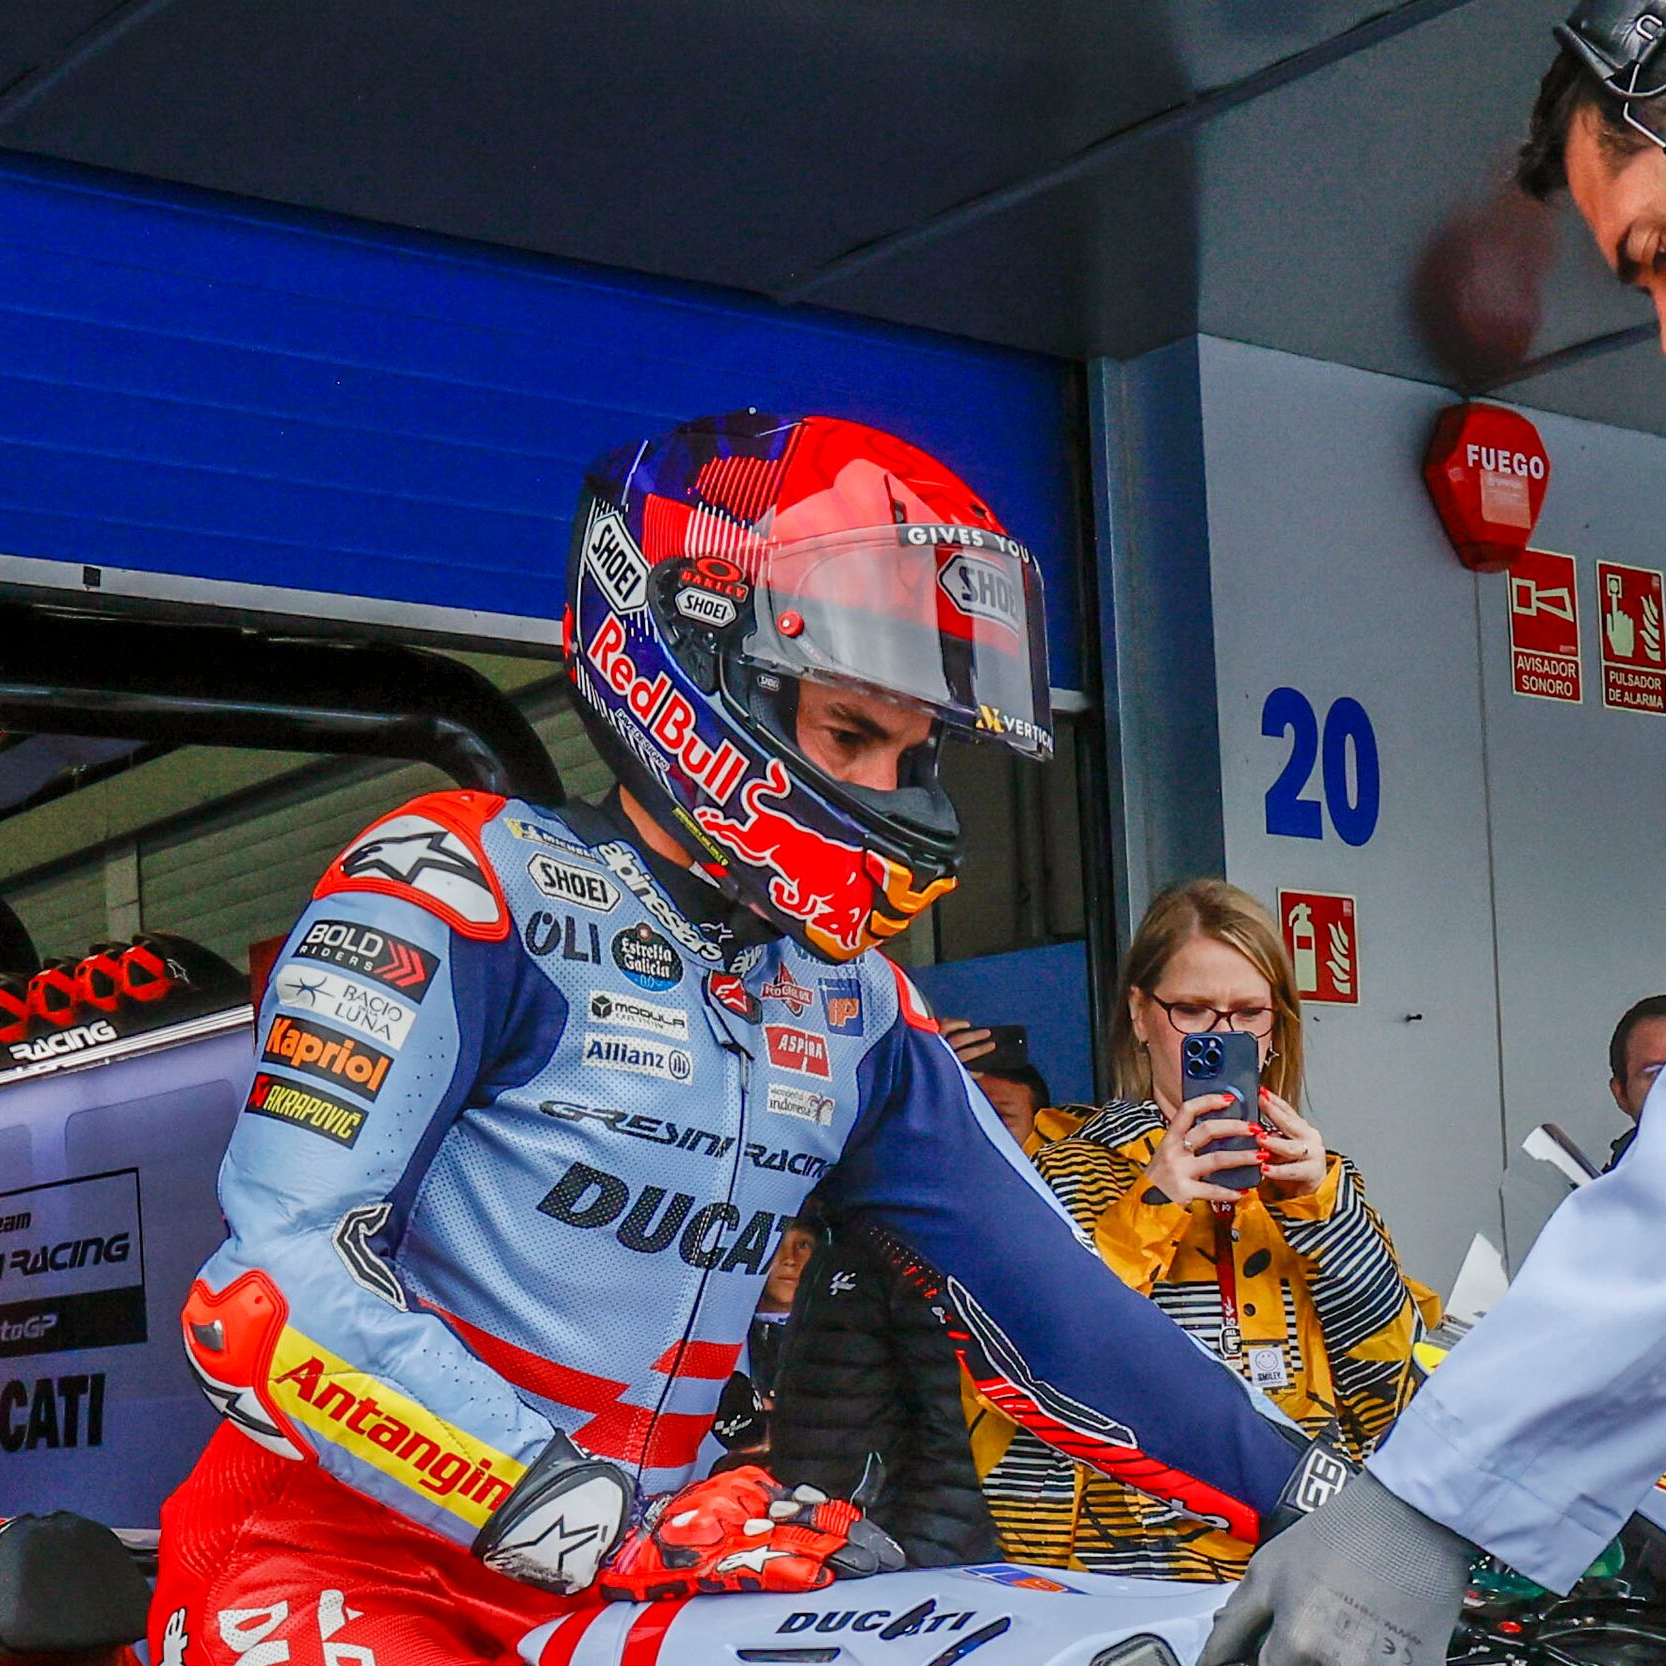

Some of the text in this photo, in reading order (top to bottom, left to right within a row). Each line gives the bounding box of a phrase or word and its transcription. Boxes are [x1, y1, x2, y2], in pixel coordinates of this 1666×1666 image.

[1466, 443, 1545, 480] FUEGO
[590, 523, 643, 602] SHOEI
[908, 526, 1030, 564] GIVES YOU
[680, 568, 748, 600] OAKLEY
[685, 593, 729, 620] SHOEI
[1516, 655, 1577, 680] AVISADOR
[1608, 670, 1663, 691] PULSADOR
[1521, 674, 1574, 698] SONORO
[1608, 688, 1665, 710] DE ALARMA
[1261, 686, 1380, 847] 20
[539, 861, 610, 904] SHOEI
[598, 842, 723, 961] alpinestars
[306, 923, 384, 958] BOLD
[525, 910, 601, 965] OLI
[621, 937, 673, 962] Estrella
[299, 945, 375, 972] RIDERS
[623, 953, 671, 978] Galicia
[334, 1002, 392, 1041] LUNA
[615, 1002, 685, 1028] MODULA
[9, 1019, 118, 1061] RACING
[265, 1018, 390, 1094] Kapriol
[586, 1039, 665, 1069] Allianz
[778, 1033, 823, 1060] ASPIRA
[539, 1100, 736, 1158] GRESINI
[9, 1233, 131, 1278] RACING
[276, 1356, 512, 1511] Antangin
